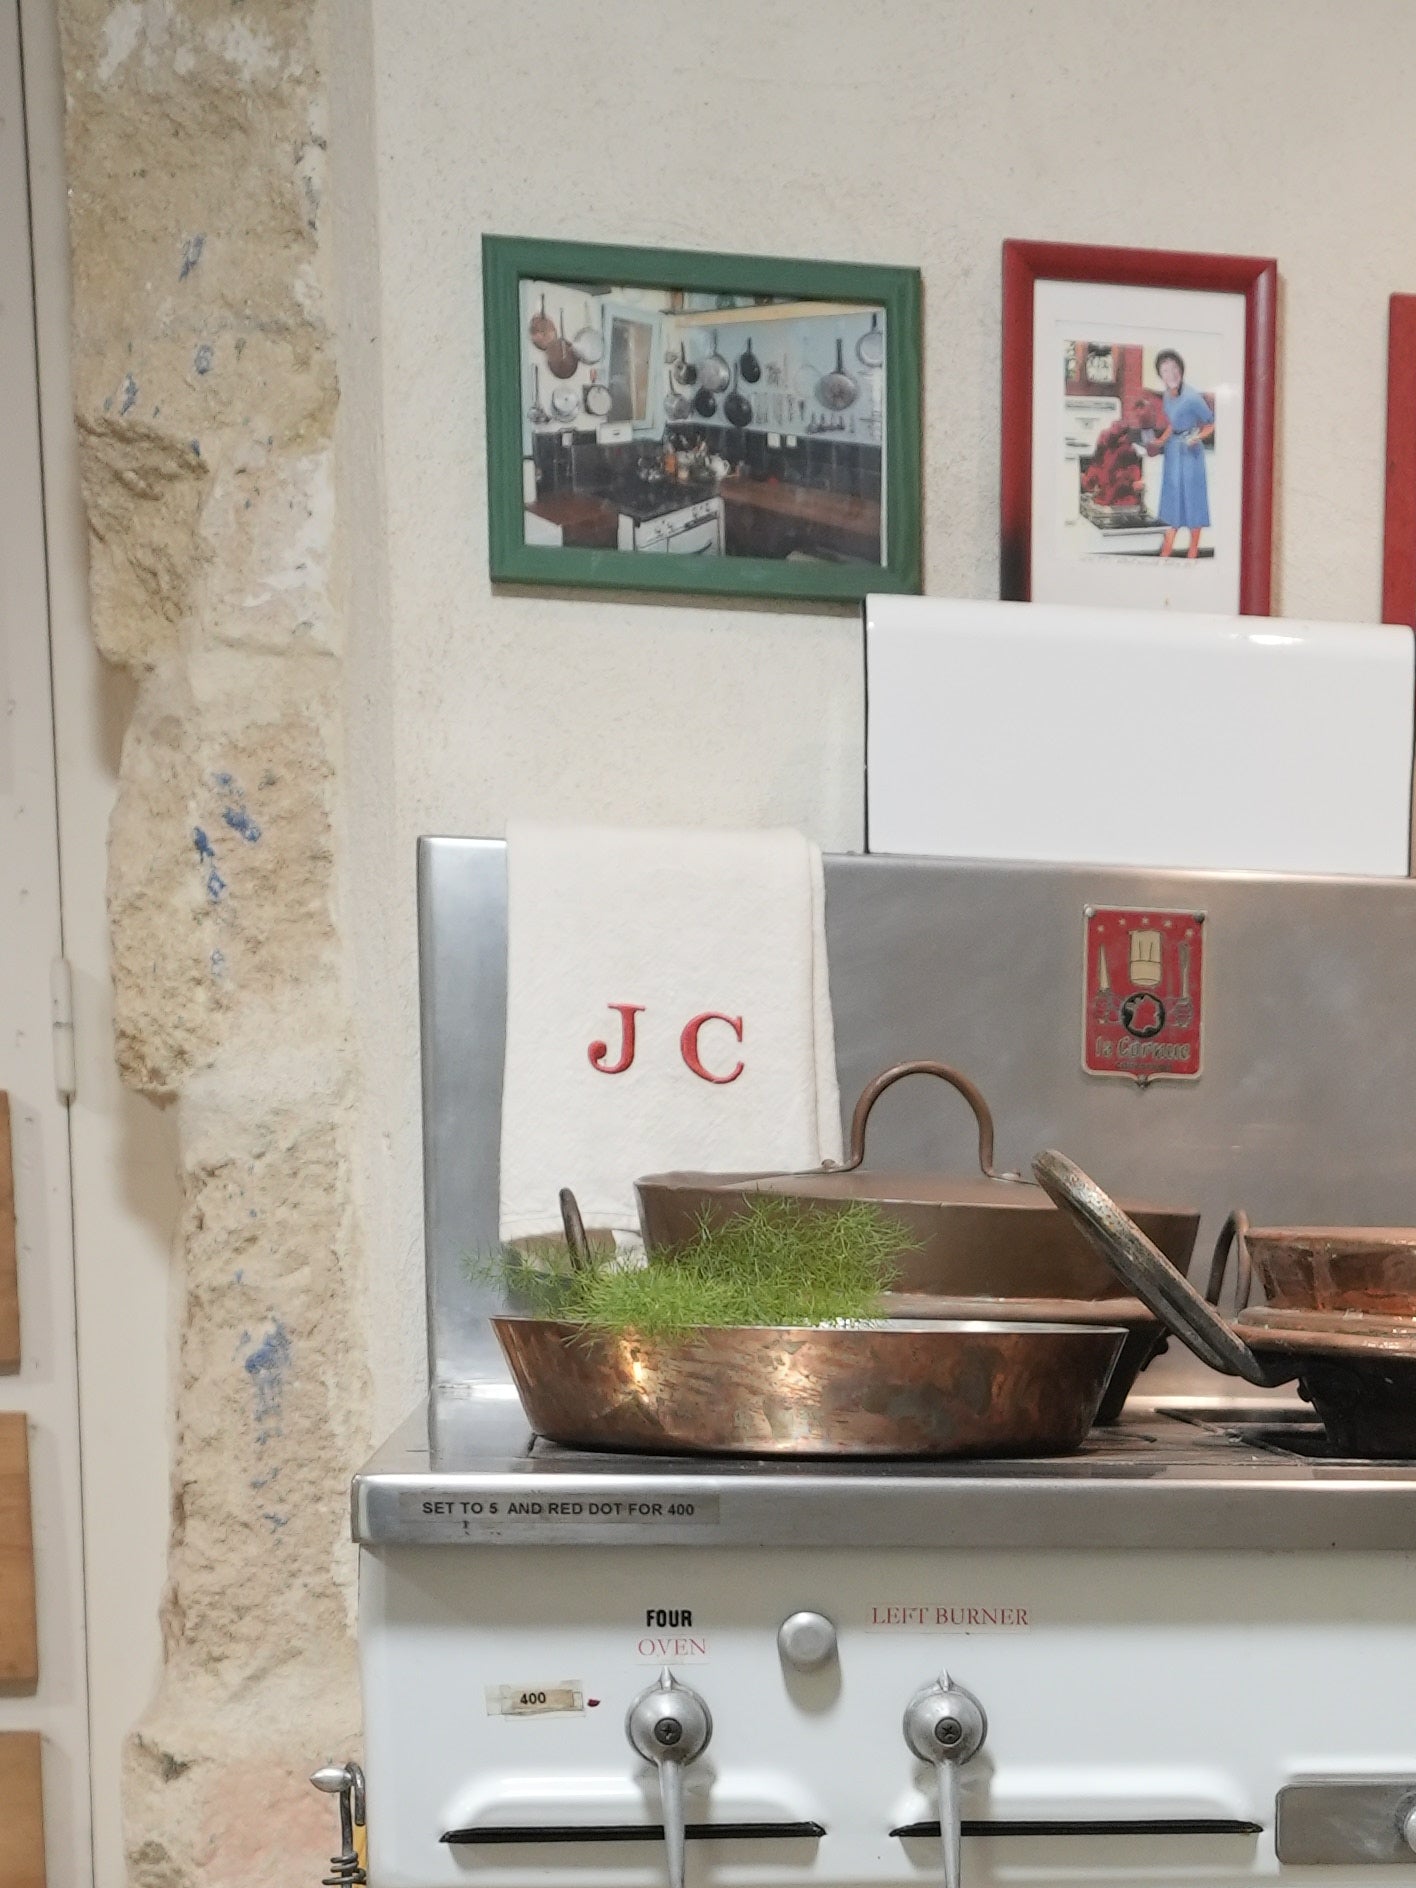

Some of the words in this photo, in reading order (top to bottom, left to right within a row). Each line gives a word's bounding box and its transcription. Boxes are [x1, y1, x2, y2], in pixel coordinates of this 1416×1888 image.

[587, 1003, 646, 1075] J
[680, 1011, 745, 1084] C
[422, 1501, 454, 1515] SET
[461, 1502, 484, 1515] TO
[489, 1502, 499, 1515] 5
[507, 1502, 543, 1516] AND
[548, 1502, 584, 1516] RED
[588, 1502, 623, 1516] DOT
[628, 1502, 663, 1516] FOR
[667, 1502, 695, 1516] 400
[645, 1609, 693, 1628] FOUR
[871, 1606, 929, 1625] LEFT
[935, 1607, 1029, 1626] BURNER
[637, 1638, 707, 1657] OVEN
[519, 1691, 547, 1706] 400
